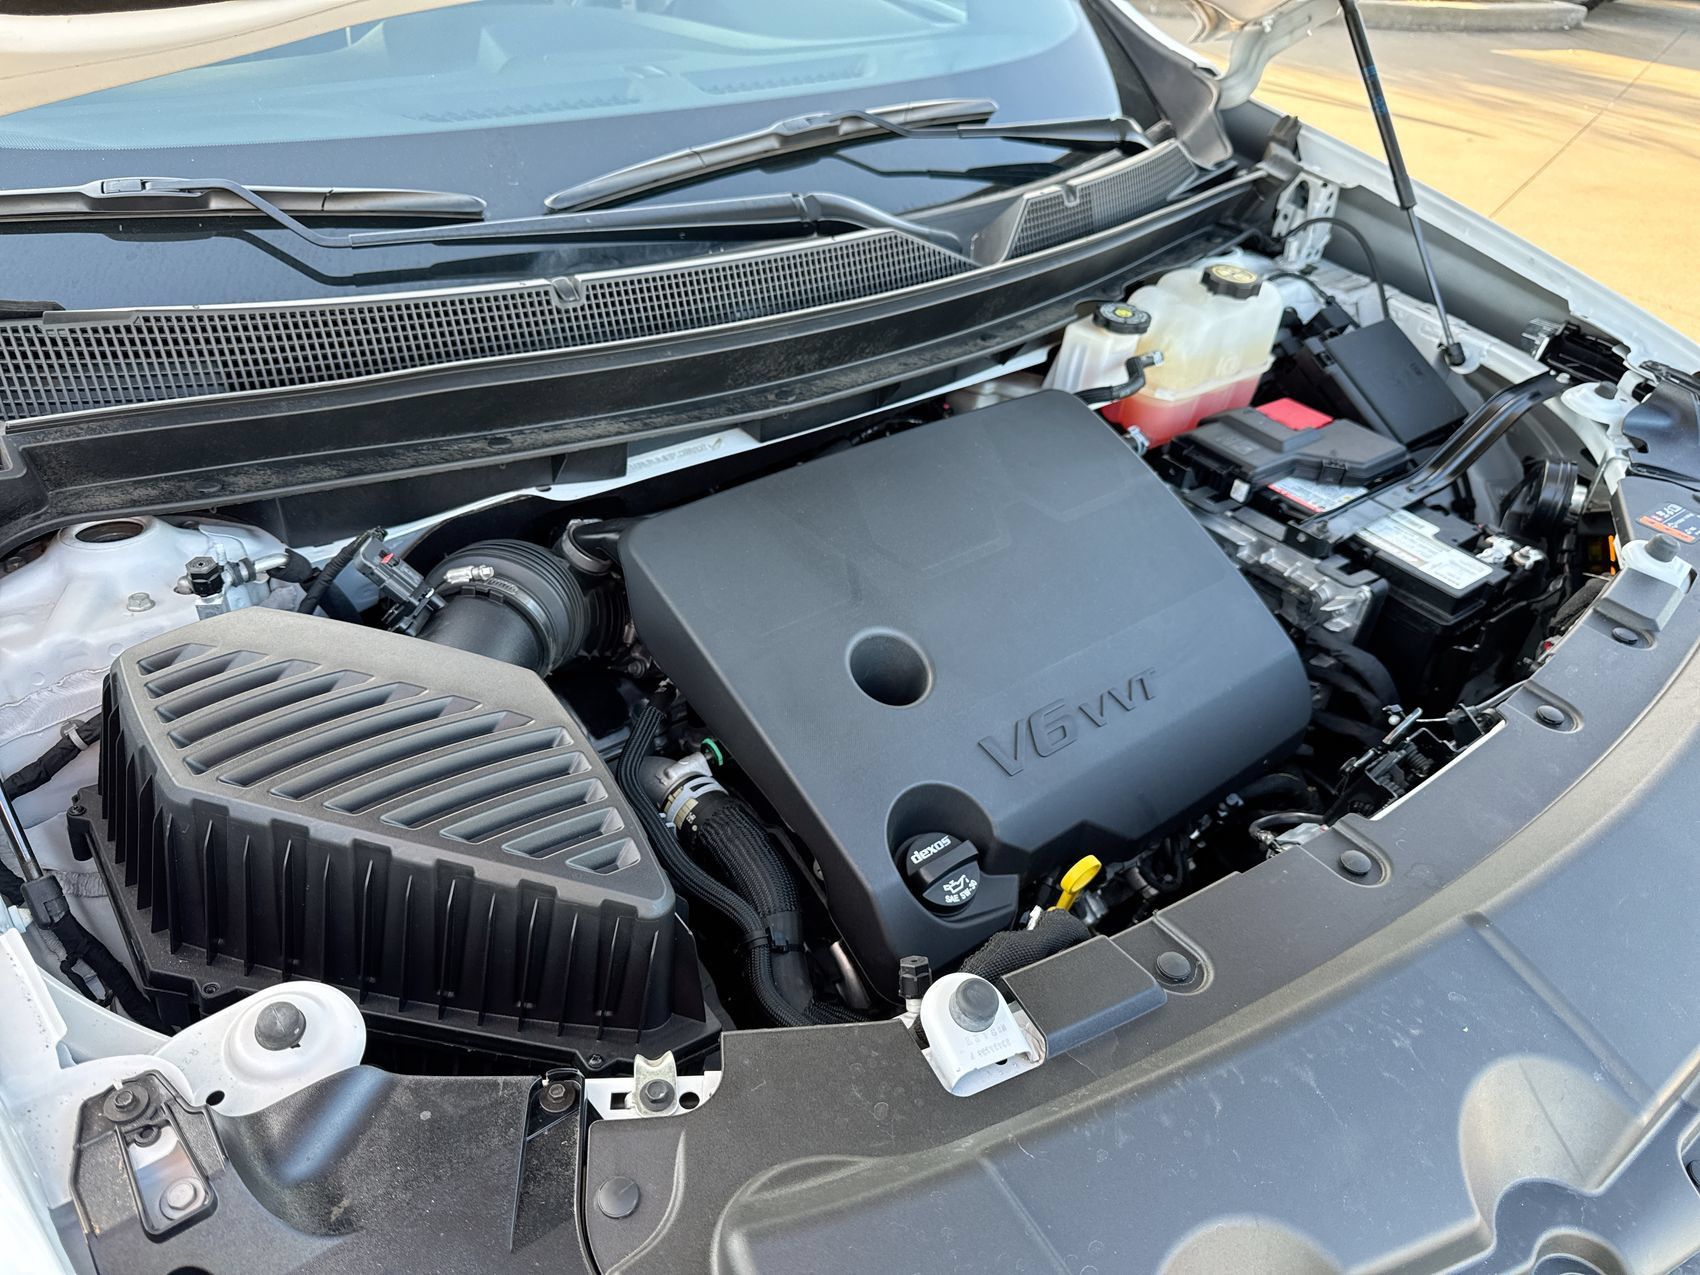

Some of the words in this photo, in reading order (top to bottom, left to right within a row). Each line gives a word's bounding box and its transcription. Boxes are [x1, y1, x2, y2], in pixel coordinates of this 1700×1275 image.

[977, 698, 1079, 777] V6
[1078, 667, 1157, 728] VVT
[910, 834, 952, 865] dexos
[944, 893, 961, 903] SAE
[959, 879, 978, 900] 5W-30
